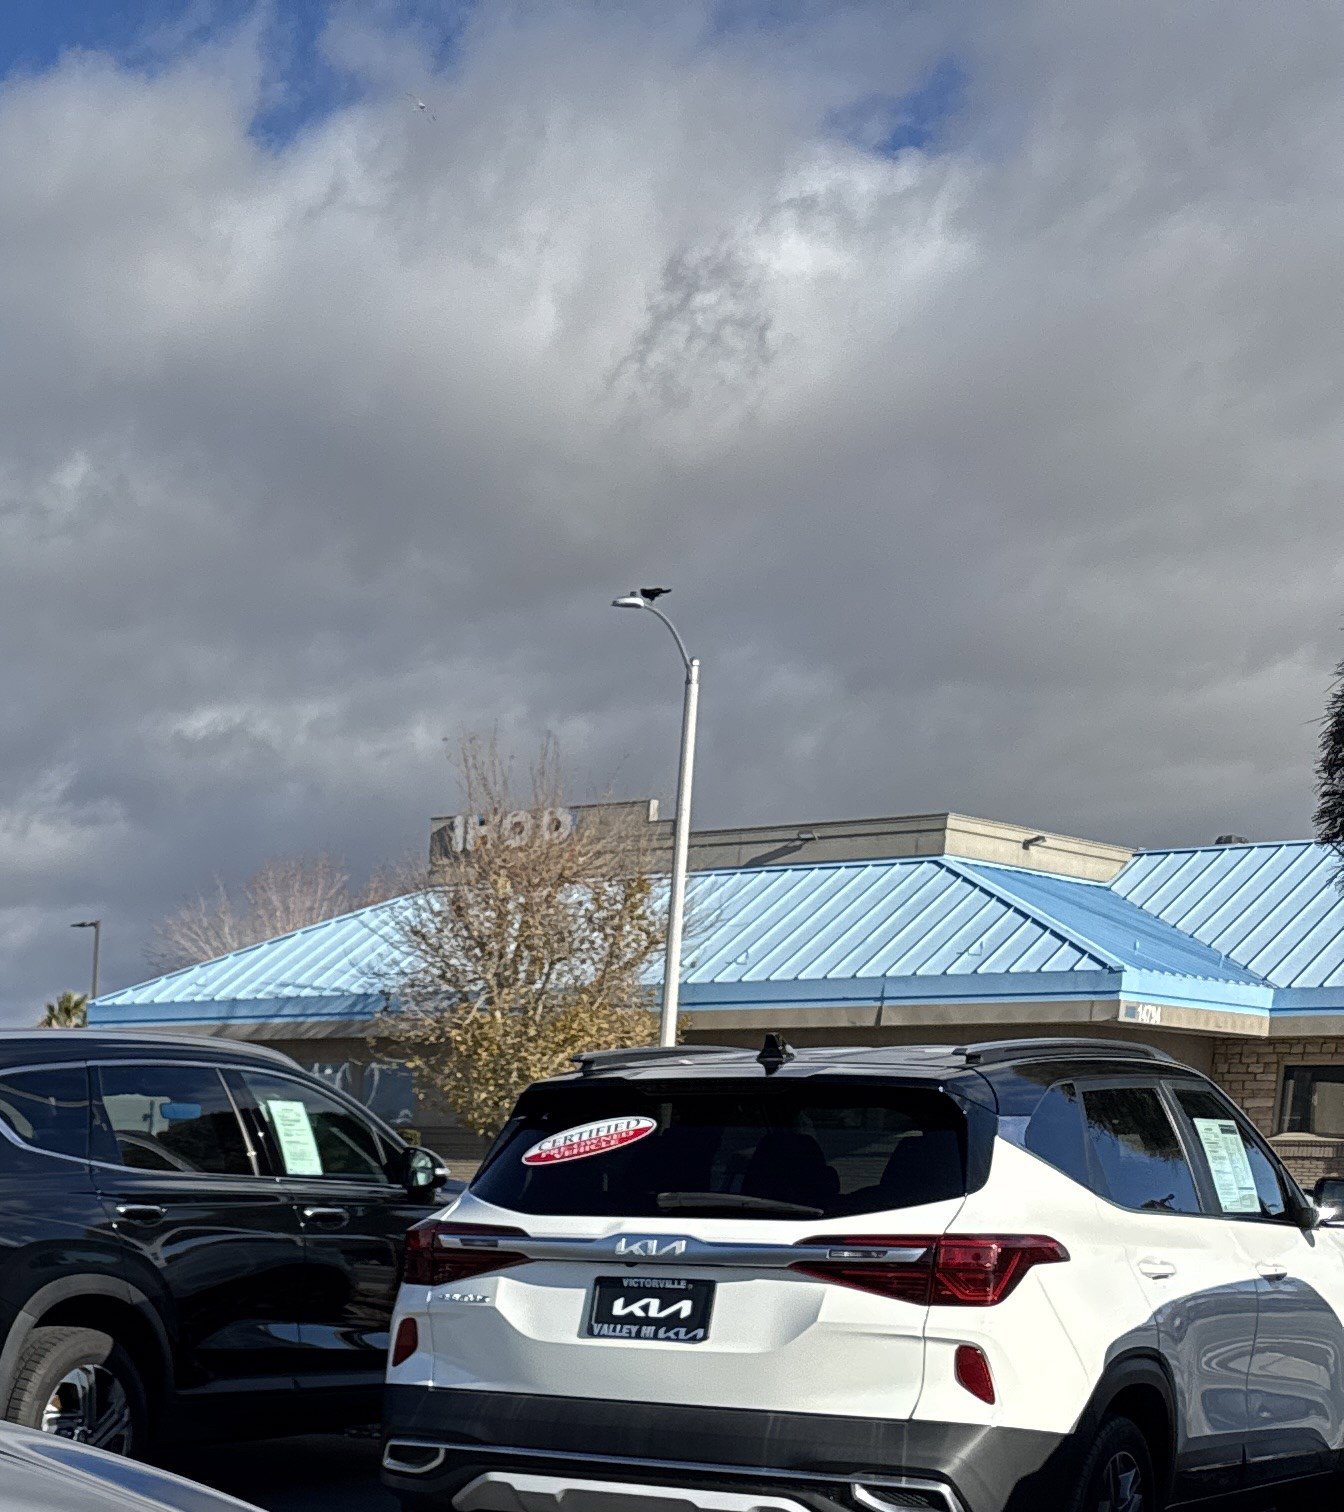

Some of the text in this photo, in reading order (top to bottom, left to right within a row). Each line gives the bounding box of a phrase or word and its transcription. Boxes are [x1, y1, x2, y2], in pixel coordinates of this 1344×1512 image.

[538, 1118, 642, 1152] CERTIFIED
[615, 1238, 686, 1256] KIA
[622, 1278, 687, 1289] VICTORVILLE
[612, 1296, 693, 1319] KIA
[592, 1323, 705, 1340] VALLEY HI KIA
